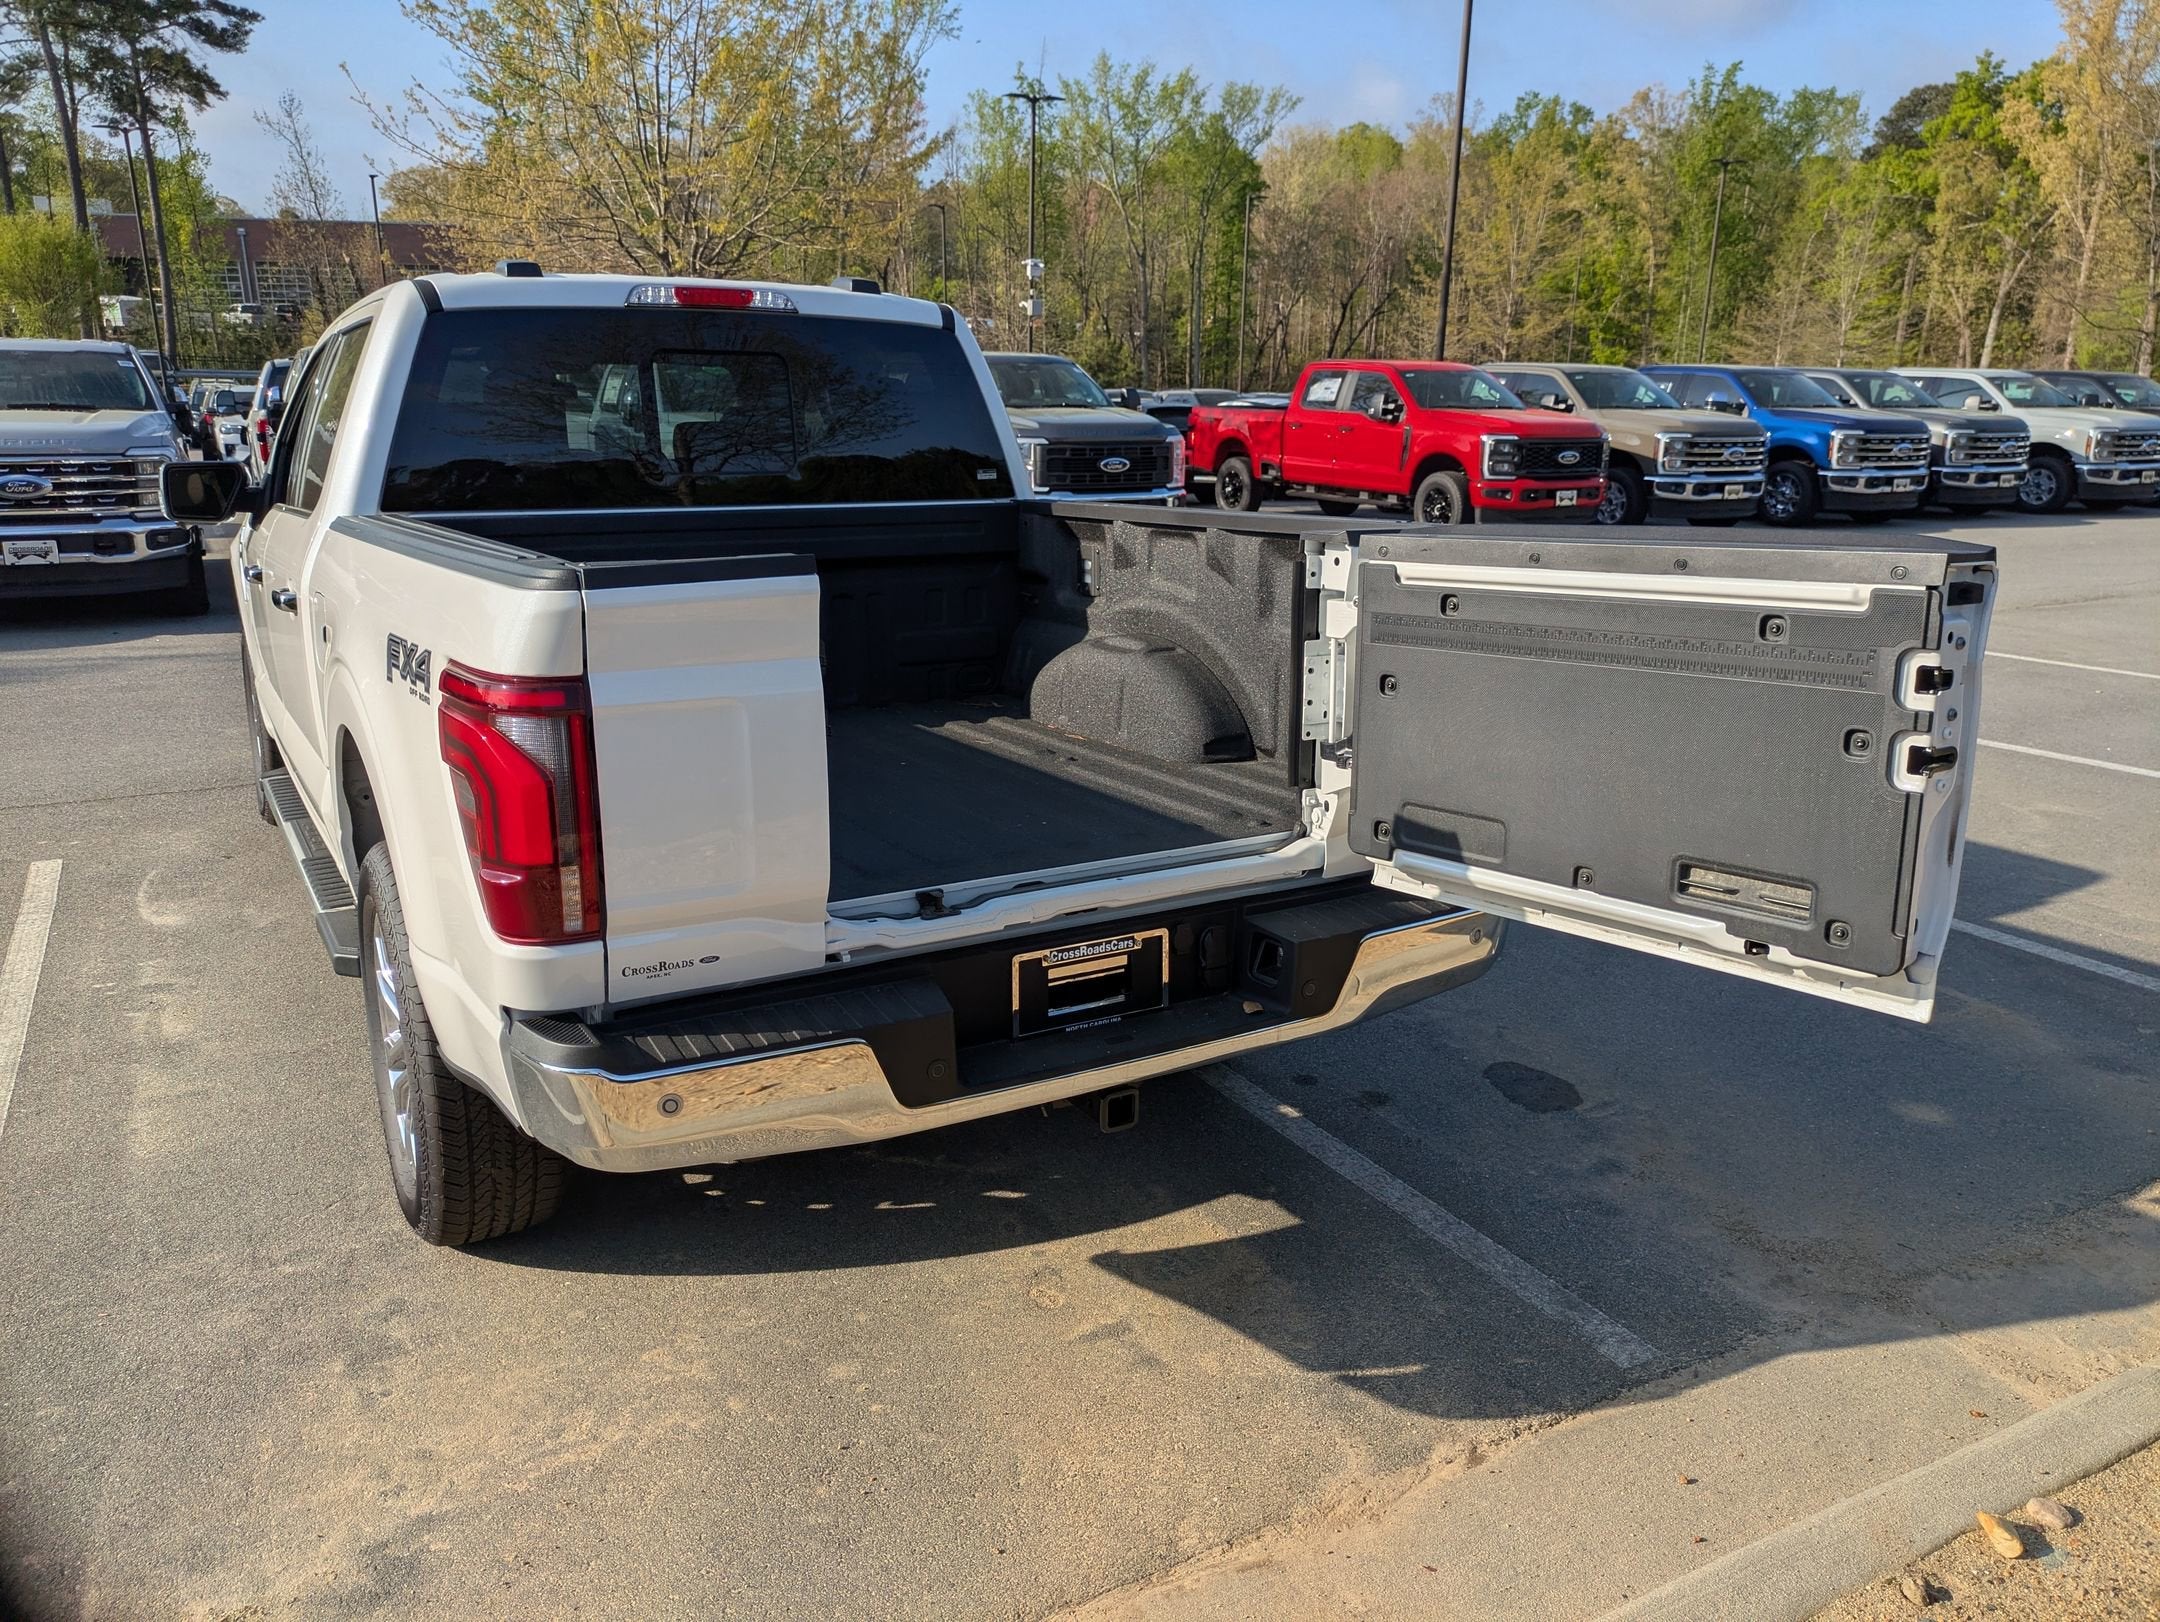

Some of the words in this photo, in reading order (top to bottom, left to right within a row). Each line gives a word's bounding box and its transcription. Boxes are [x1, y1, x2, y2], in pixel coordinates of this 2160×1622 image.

[5, 481, 35, 492] Ford
[386, 632, 432, 694] FX4
[1050, 939, 1134, 961] CrossRoadsCars
